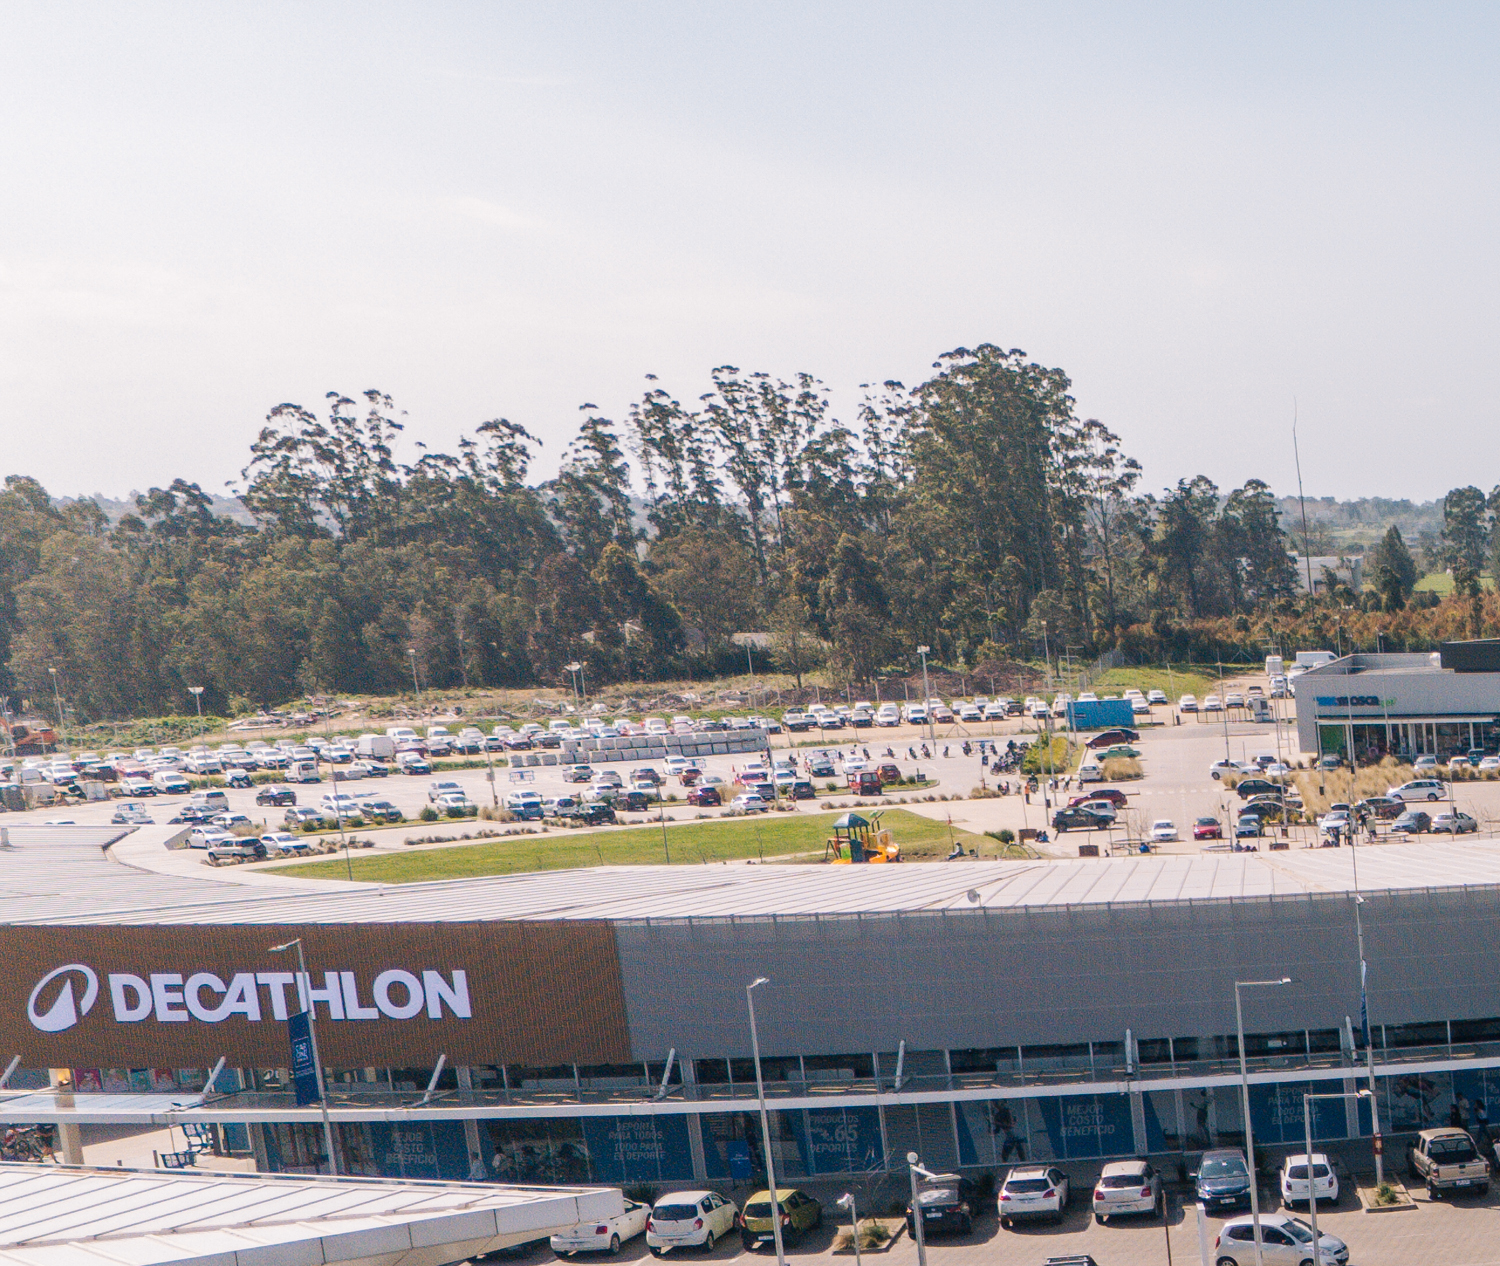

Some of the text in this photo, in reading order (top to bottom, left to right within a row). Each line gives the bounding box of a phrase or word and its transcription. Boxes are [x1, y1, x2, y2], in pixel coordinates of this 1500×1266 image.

[108, 969, 472, 1023] DECATHLON
[1067, 1104, 1103, 1114] MEJOR
[1068, 1115, 1103, 1125] COSTO
[834, 1124, 858, 1141] 65
